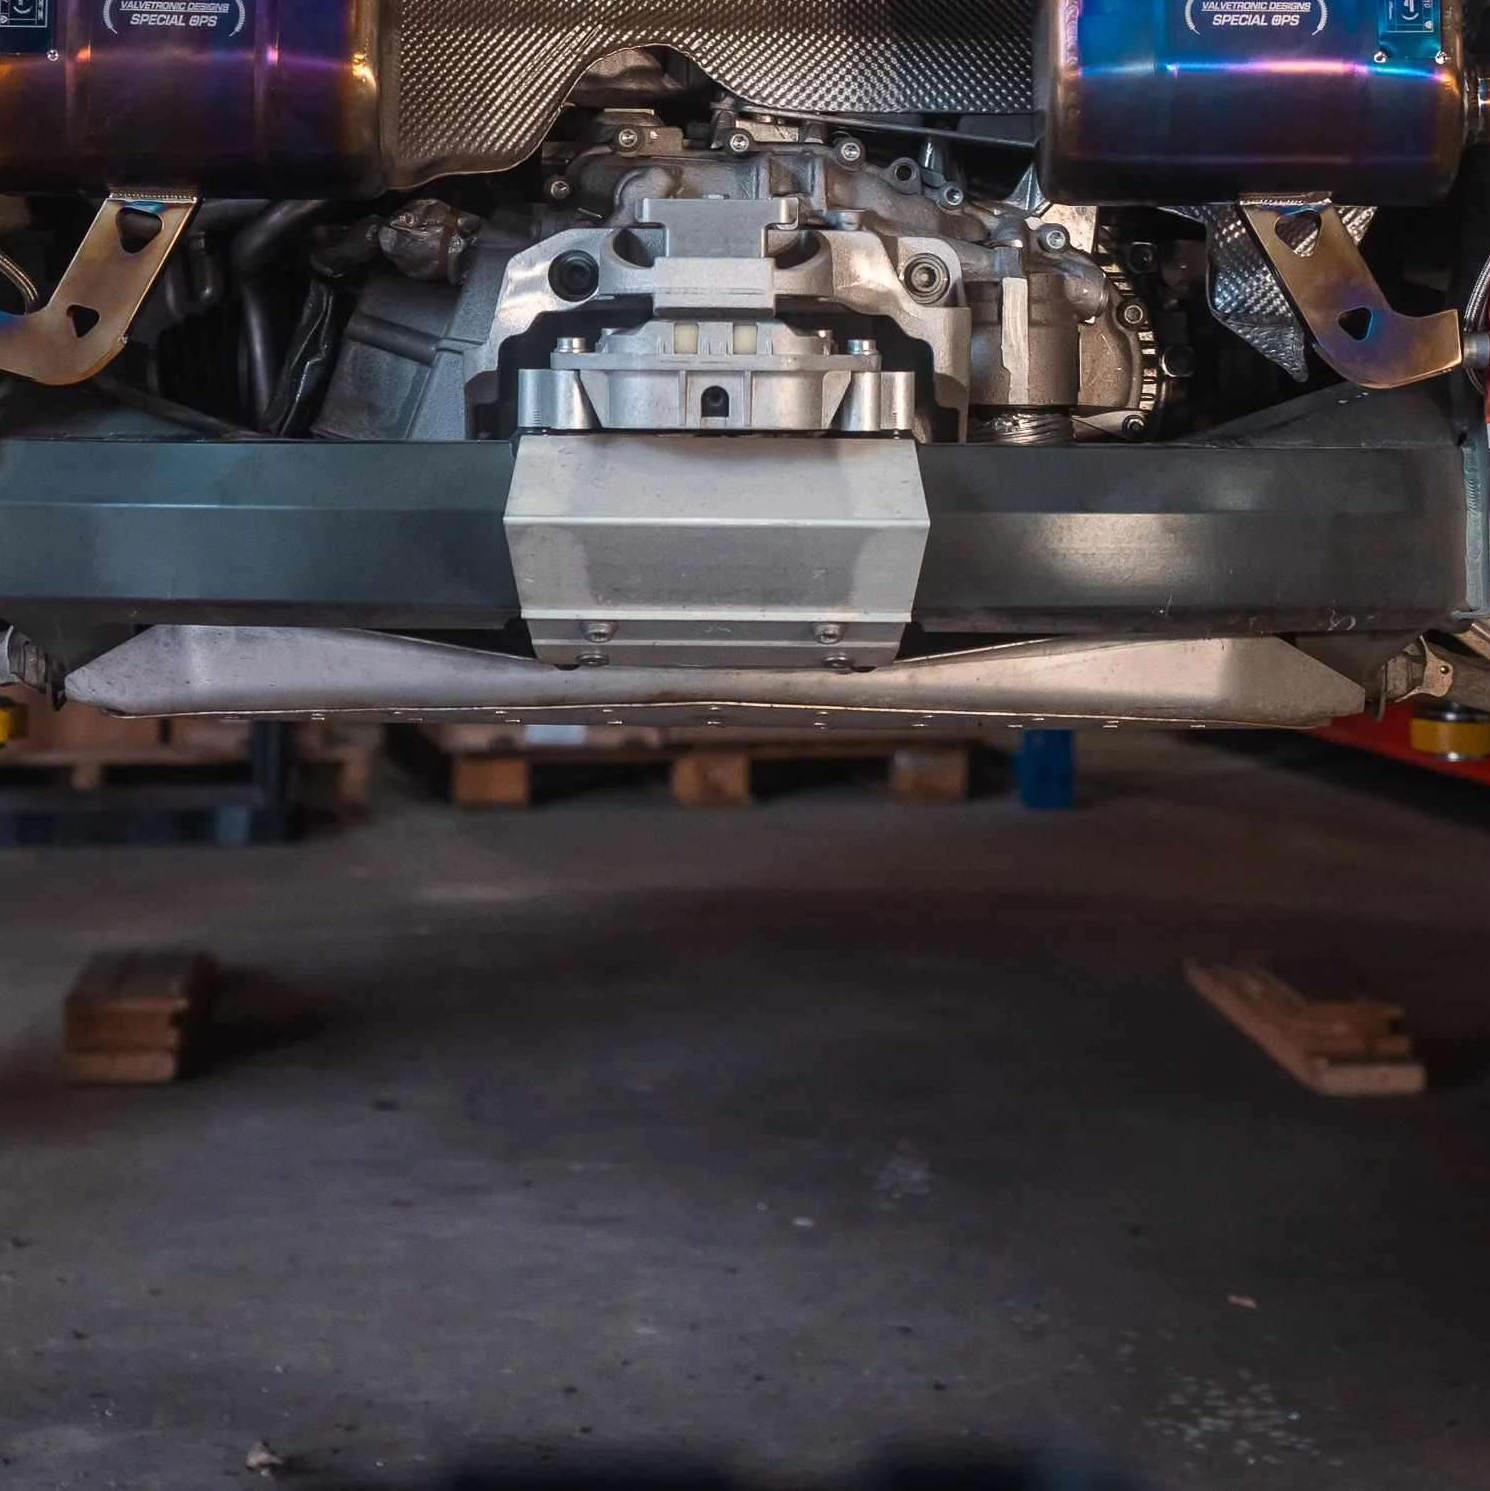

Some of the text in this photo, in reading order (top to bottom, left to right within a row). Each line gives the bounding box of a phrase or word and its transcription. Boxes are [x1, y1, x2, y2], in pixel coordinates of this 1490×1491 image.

[120, 0, 230, 11] VALVETRONIC DESIGNS
[1202, 1, 1312, 10] VALVETRONIC DESIGNS
[130, 13, 218, 27] SPECIAL OPS
[1212, 14, 1300, 26] SPECIAL OPS
